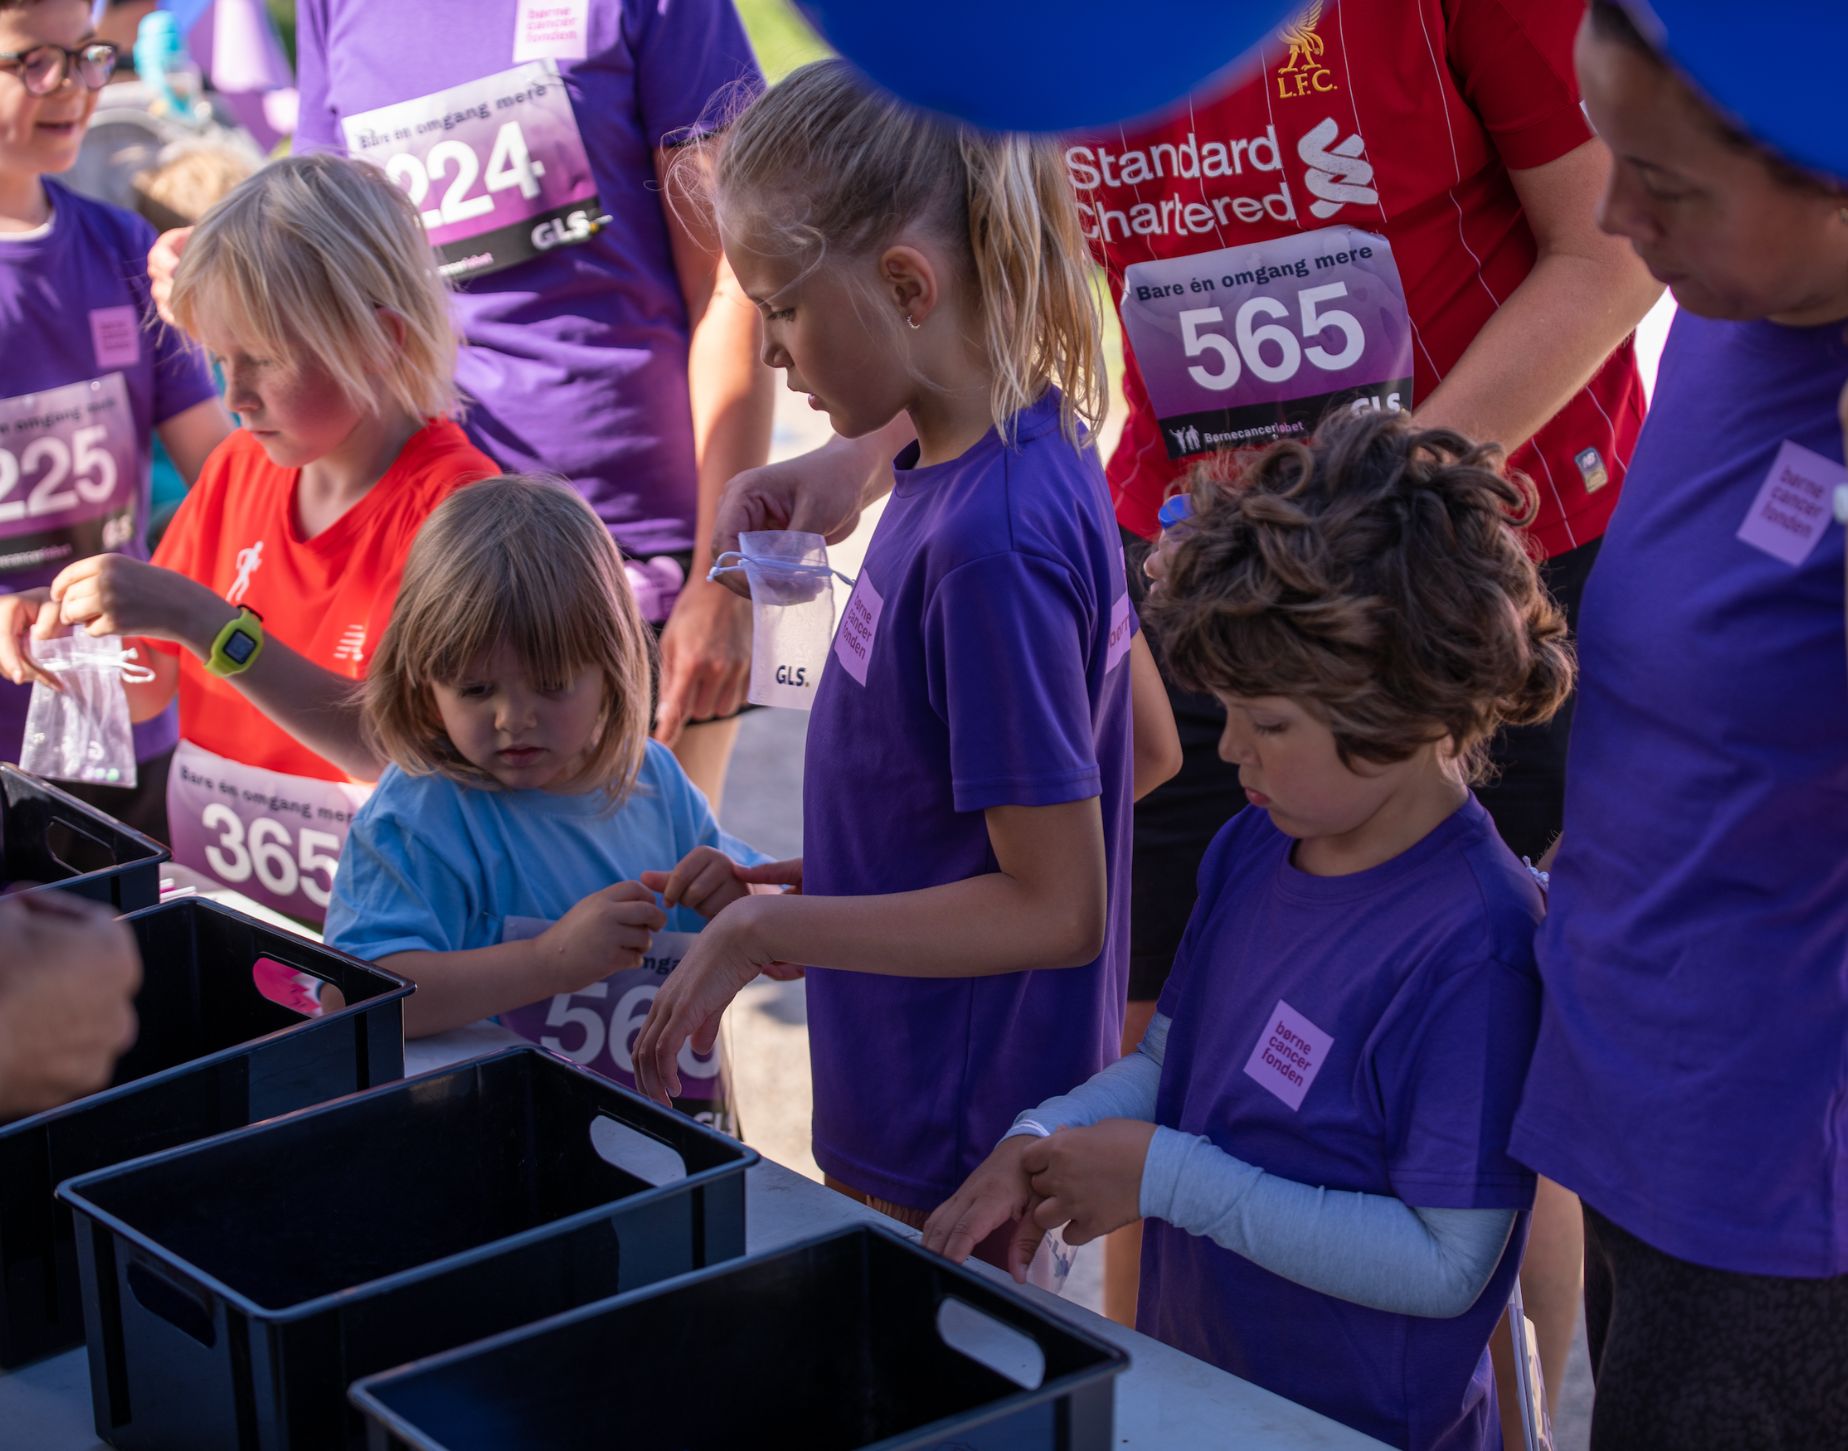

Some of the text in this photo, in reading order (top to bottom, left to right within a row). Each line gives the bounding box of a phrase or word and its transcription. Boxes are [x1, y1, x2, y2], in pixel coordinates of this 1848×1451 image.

[1278, 70, 1339, 99] L.F.C.
[416, 102, 491, 131] omgang
[386, 121, 546, 230] 224
[1065, 124, 1284, 191] Standard
[1074, 182, 1297, 243] Chartered
[1136, 246, 1374, 302] Bare én omgang mere
[1179, 281, 1366, 392] 565
[848, 608, 873, 642] cancer
[242, 789, 313, 820] omgang
[317, 807, 354, 823] mer
[202, 803, 340, 909] 365
[540, 981, 722, 1080] 56
[1268, 1036, 1312, 1071] cancer
[1275, 1020, 1313, 1056] børne
[1261, 1047, 1304, 1087] fonden
